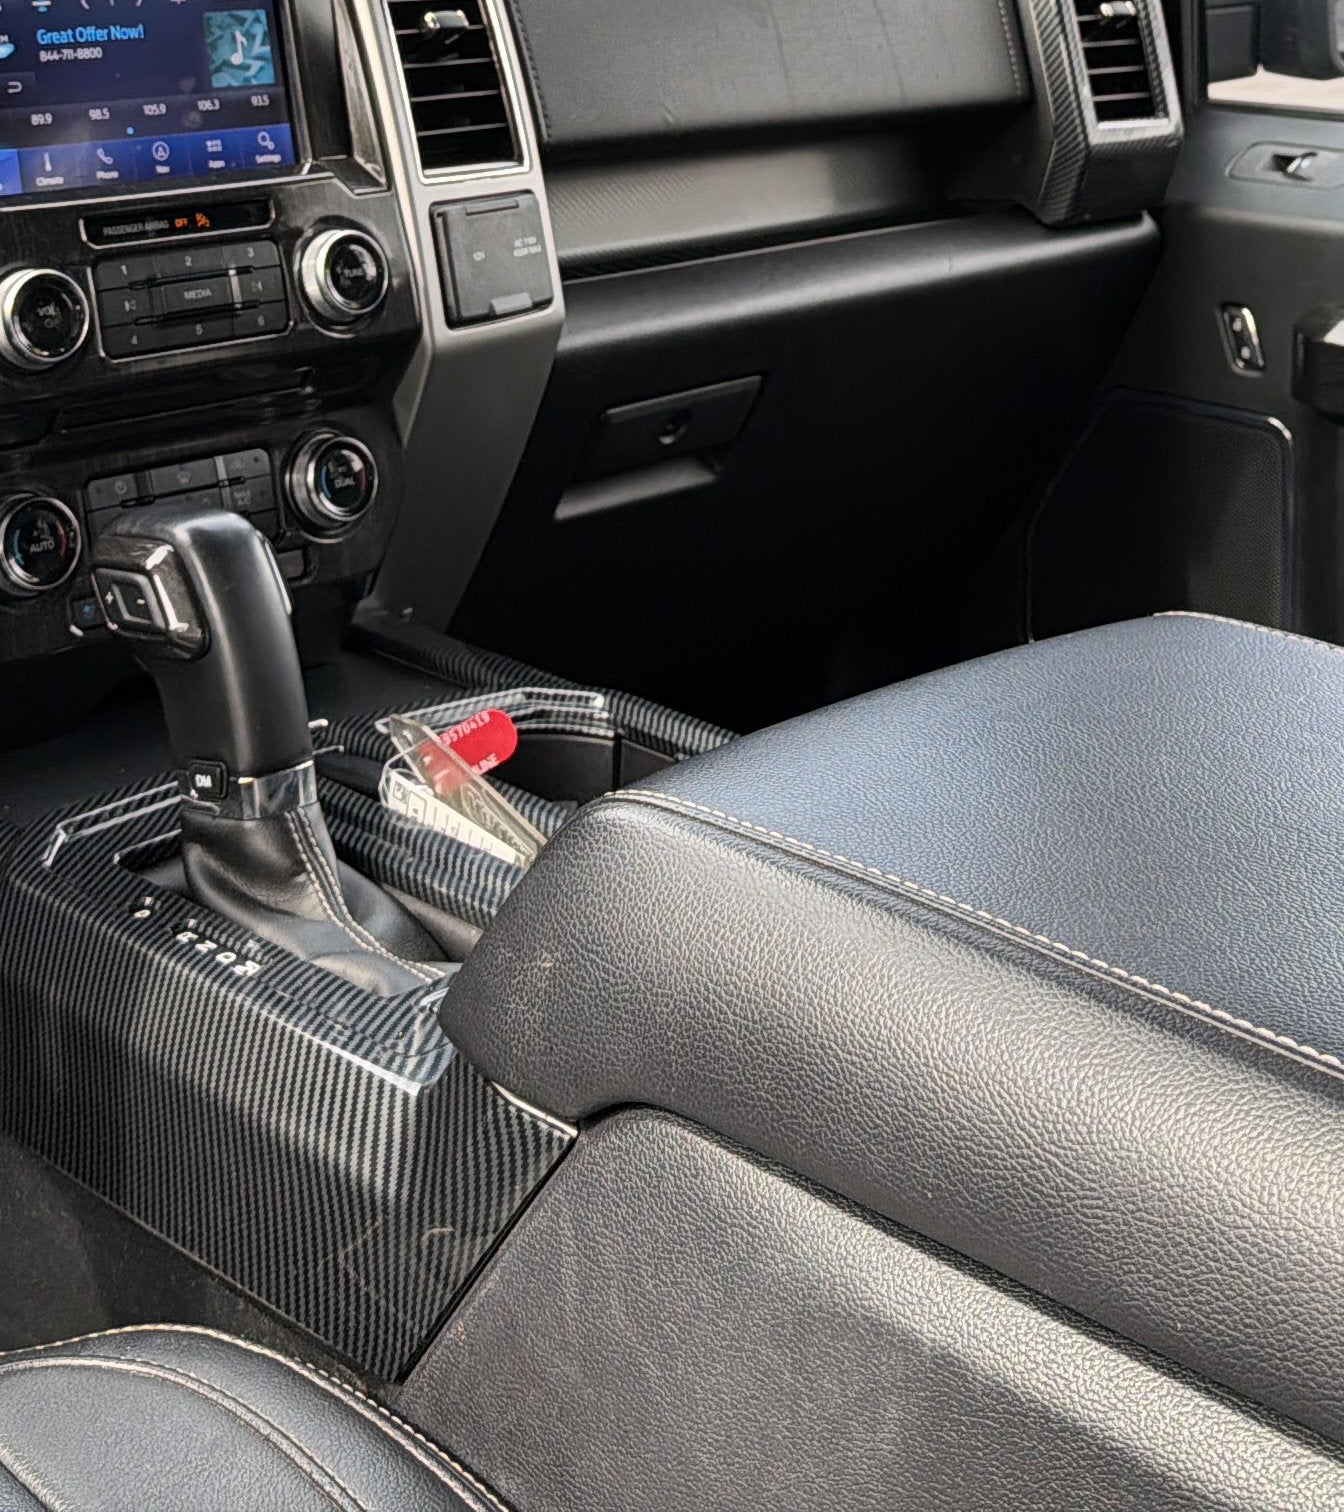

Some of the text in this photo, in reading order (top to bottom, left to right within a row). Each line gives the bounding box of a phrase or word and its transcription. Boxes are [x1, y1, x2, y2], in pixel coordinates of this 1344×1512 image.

[36, 23, 145, 45] Great Offer Now!
[39, 47, 103, 63] 844-711-8800
[246, 246, 255, 258] 3
[184, 255, 193, 267] 2
[183, 289, 213, 300] MEDIA
[29, 539, 55, 554] AUTO
